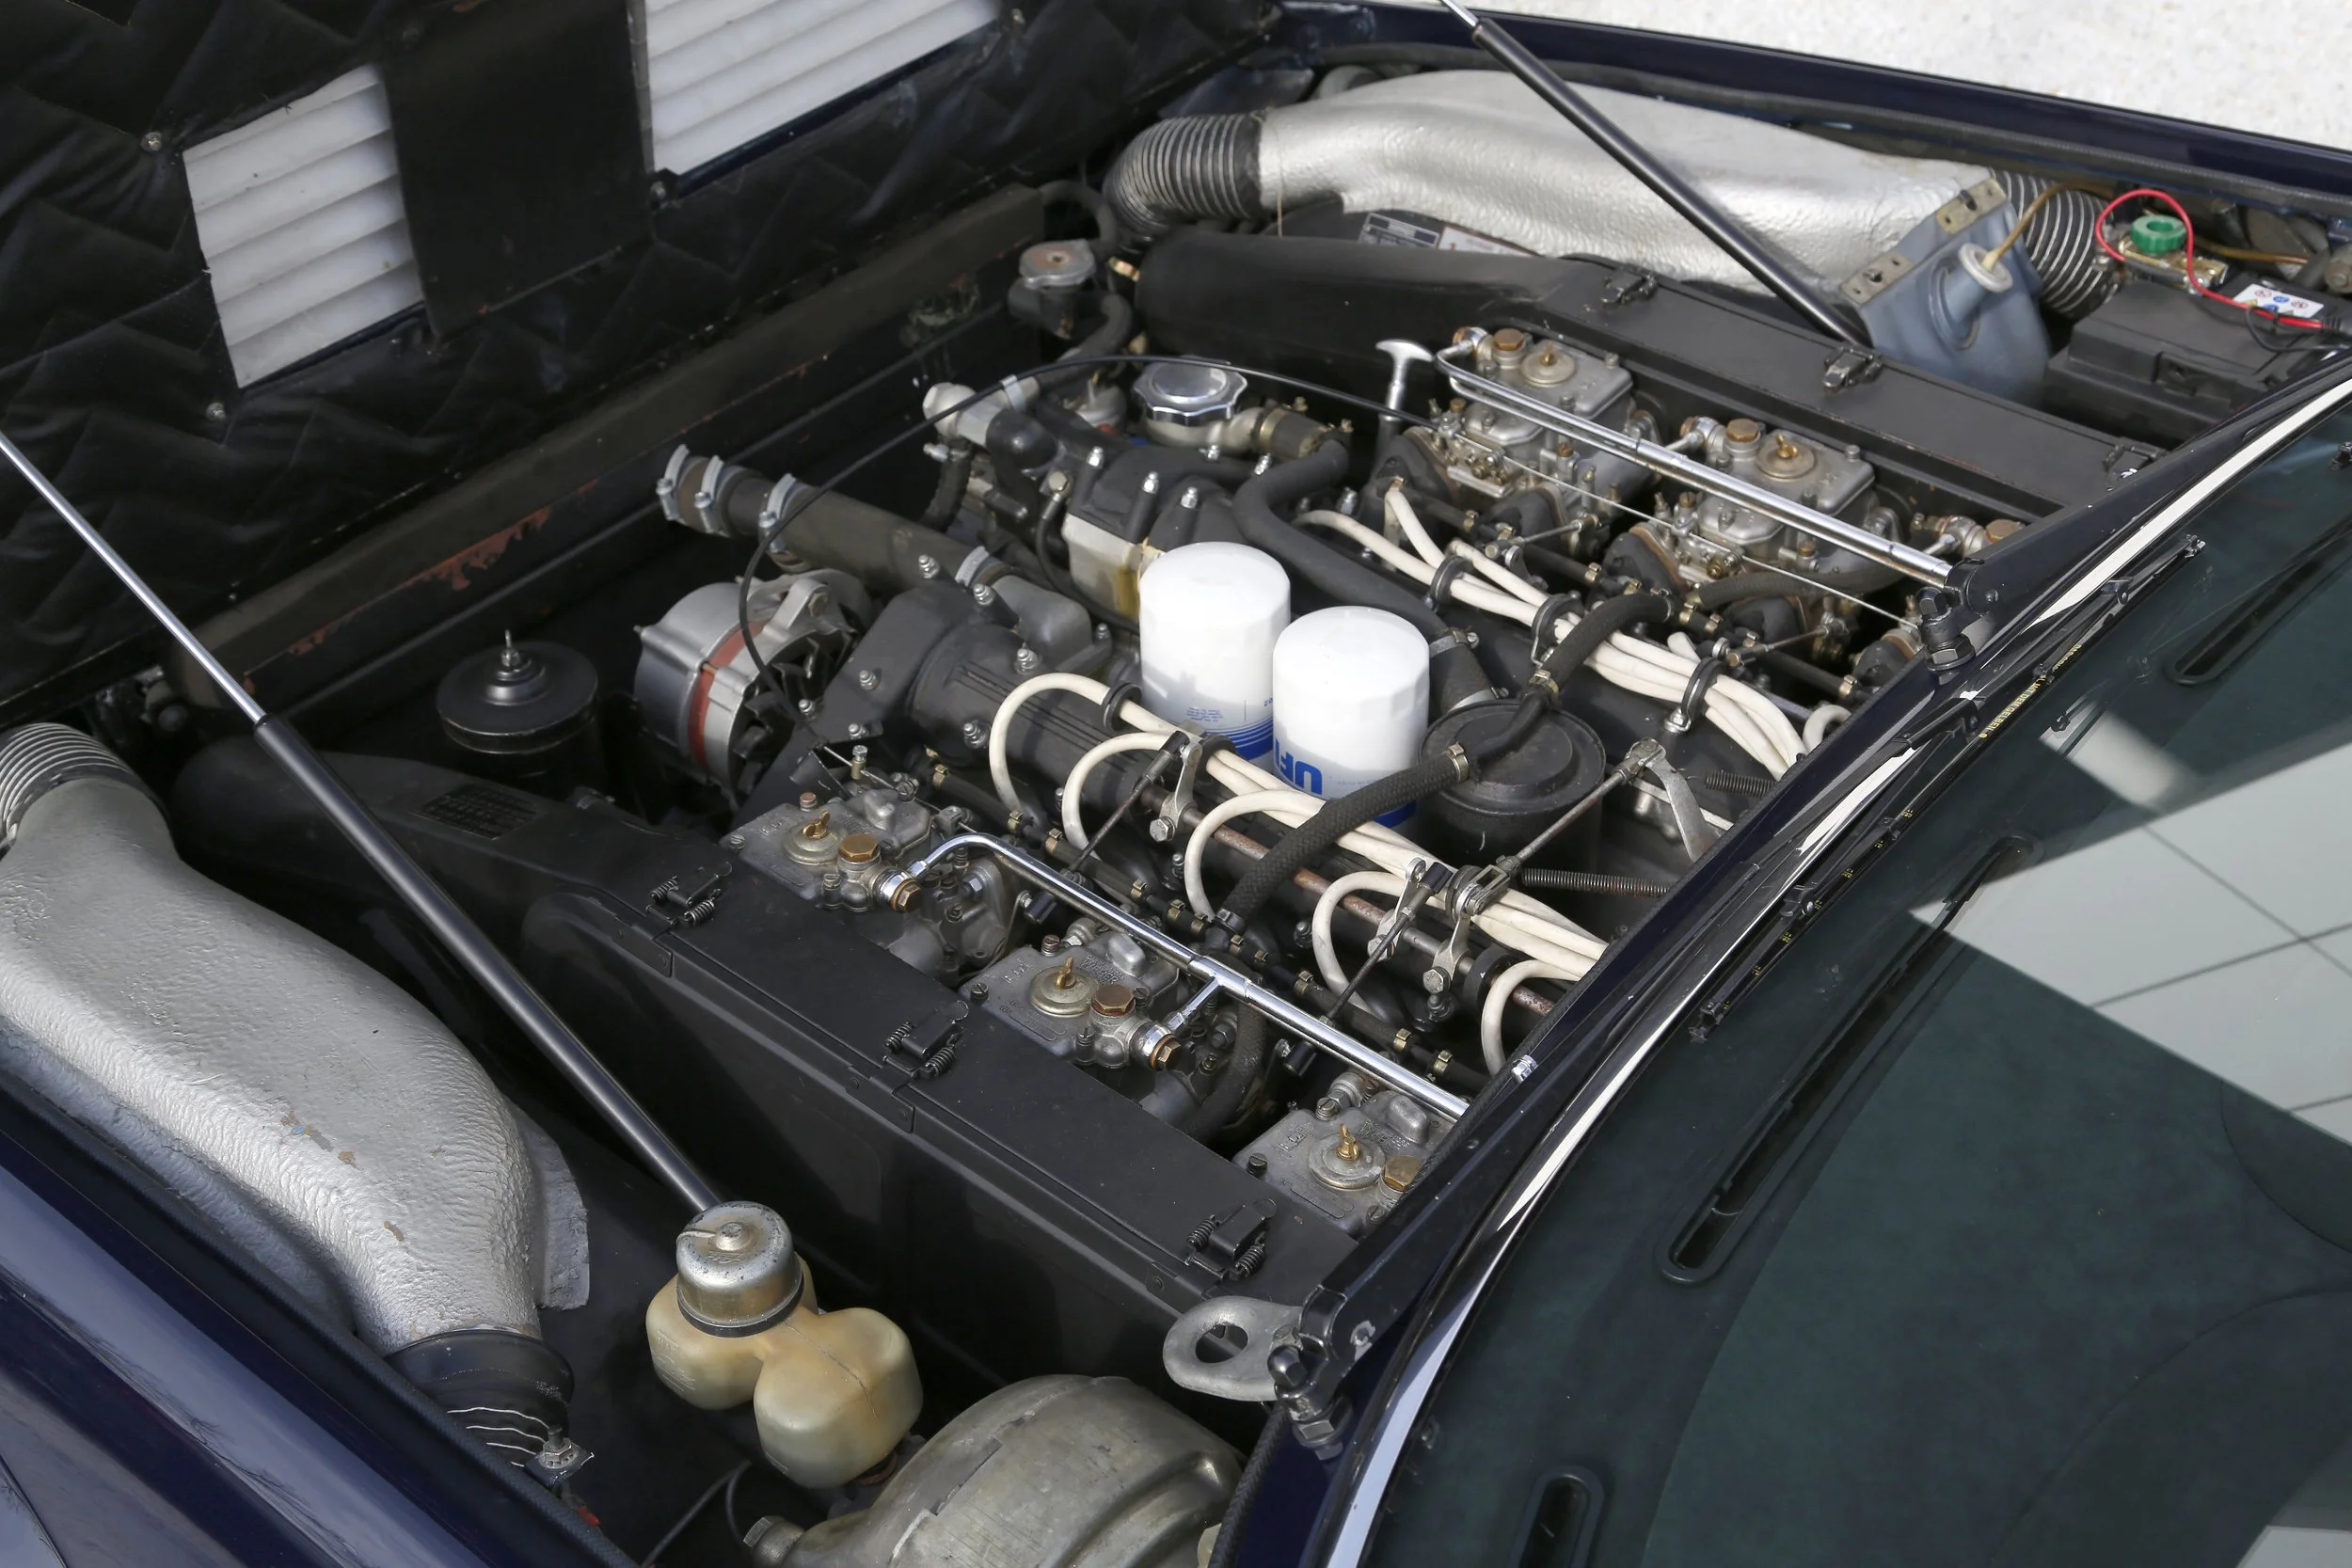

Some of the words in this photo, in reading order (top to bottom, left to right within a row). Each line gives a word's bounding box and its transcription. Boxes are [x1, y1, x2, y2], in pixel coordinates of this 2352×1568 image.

[2026, 683, 2041, 694] MIT
[2011, 693, 2029, 707] DEM
[1986, 707, 2015, 731] GELBEN
[1275, 737, 1323, 796] UFI
